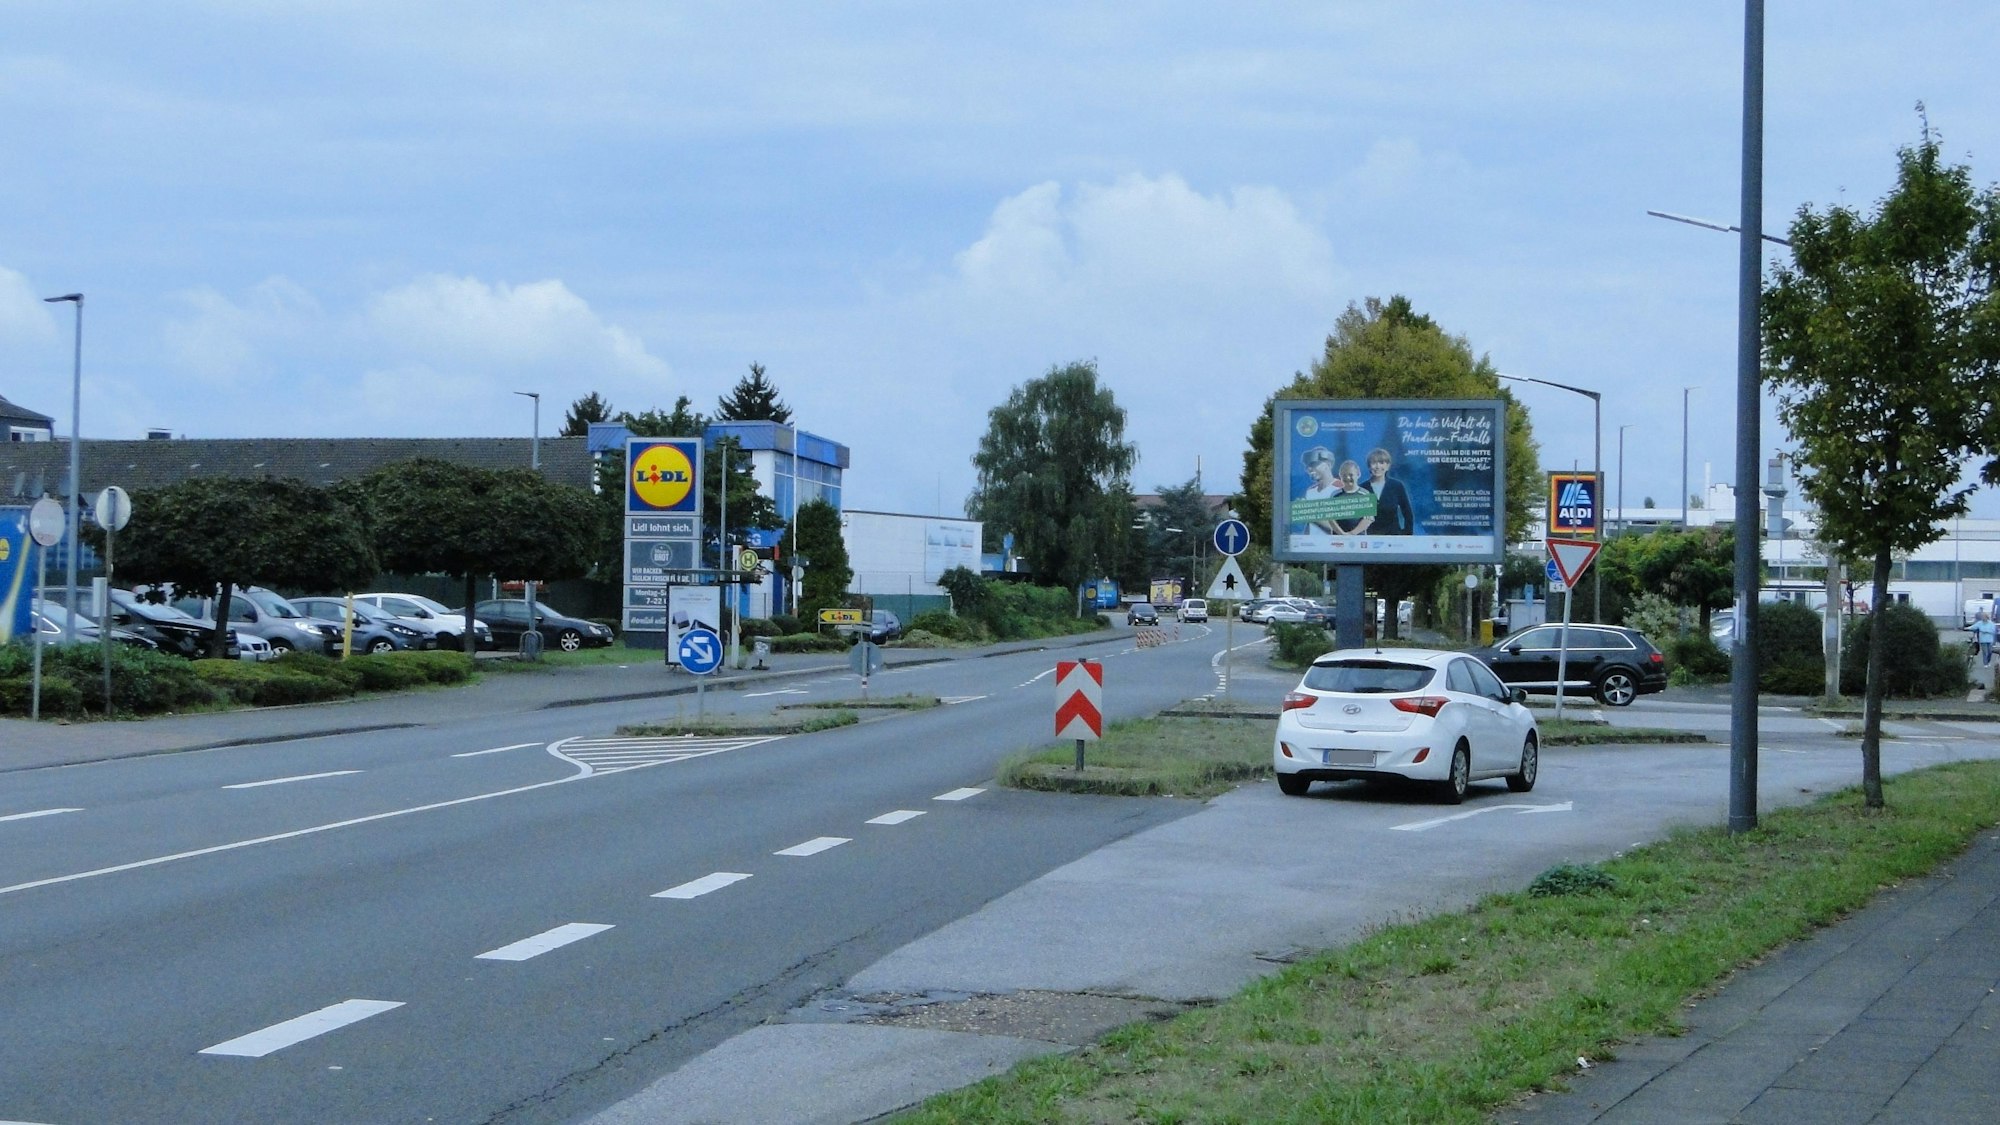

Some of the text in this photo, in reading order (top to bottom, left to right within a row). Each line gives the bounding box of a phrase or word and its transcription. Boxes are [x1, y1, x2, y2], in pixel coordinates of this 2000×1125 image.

[1415, 416, 1439, 428] bunte
[1441, 416, 1475, 430] Vielfalt
[1476, 416, 1491, 429] des
[1559, 508, 1592, 518] ALDI
[632, 523, 692, 532] Lidl lohnt sich.
